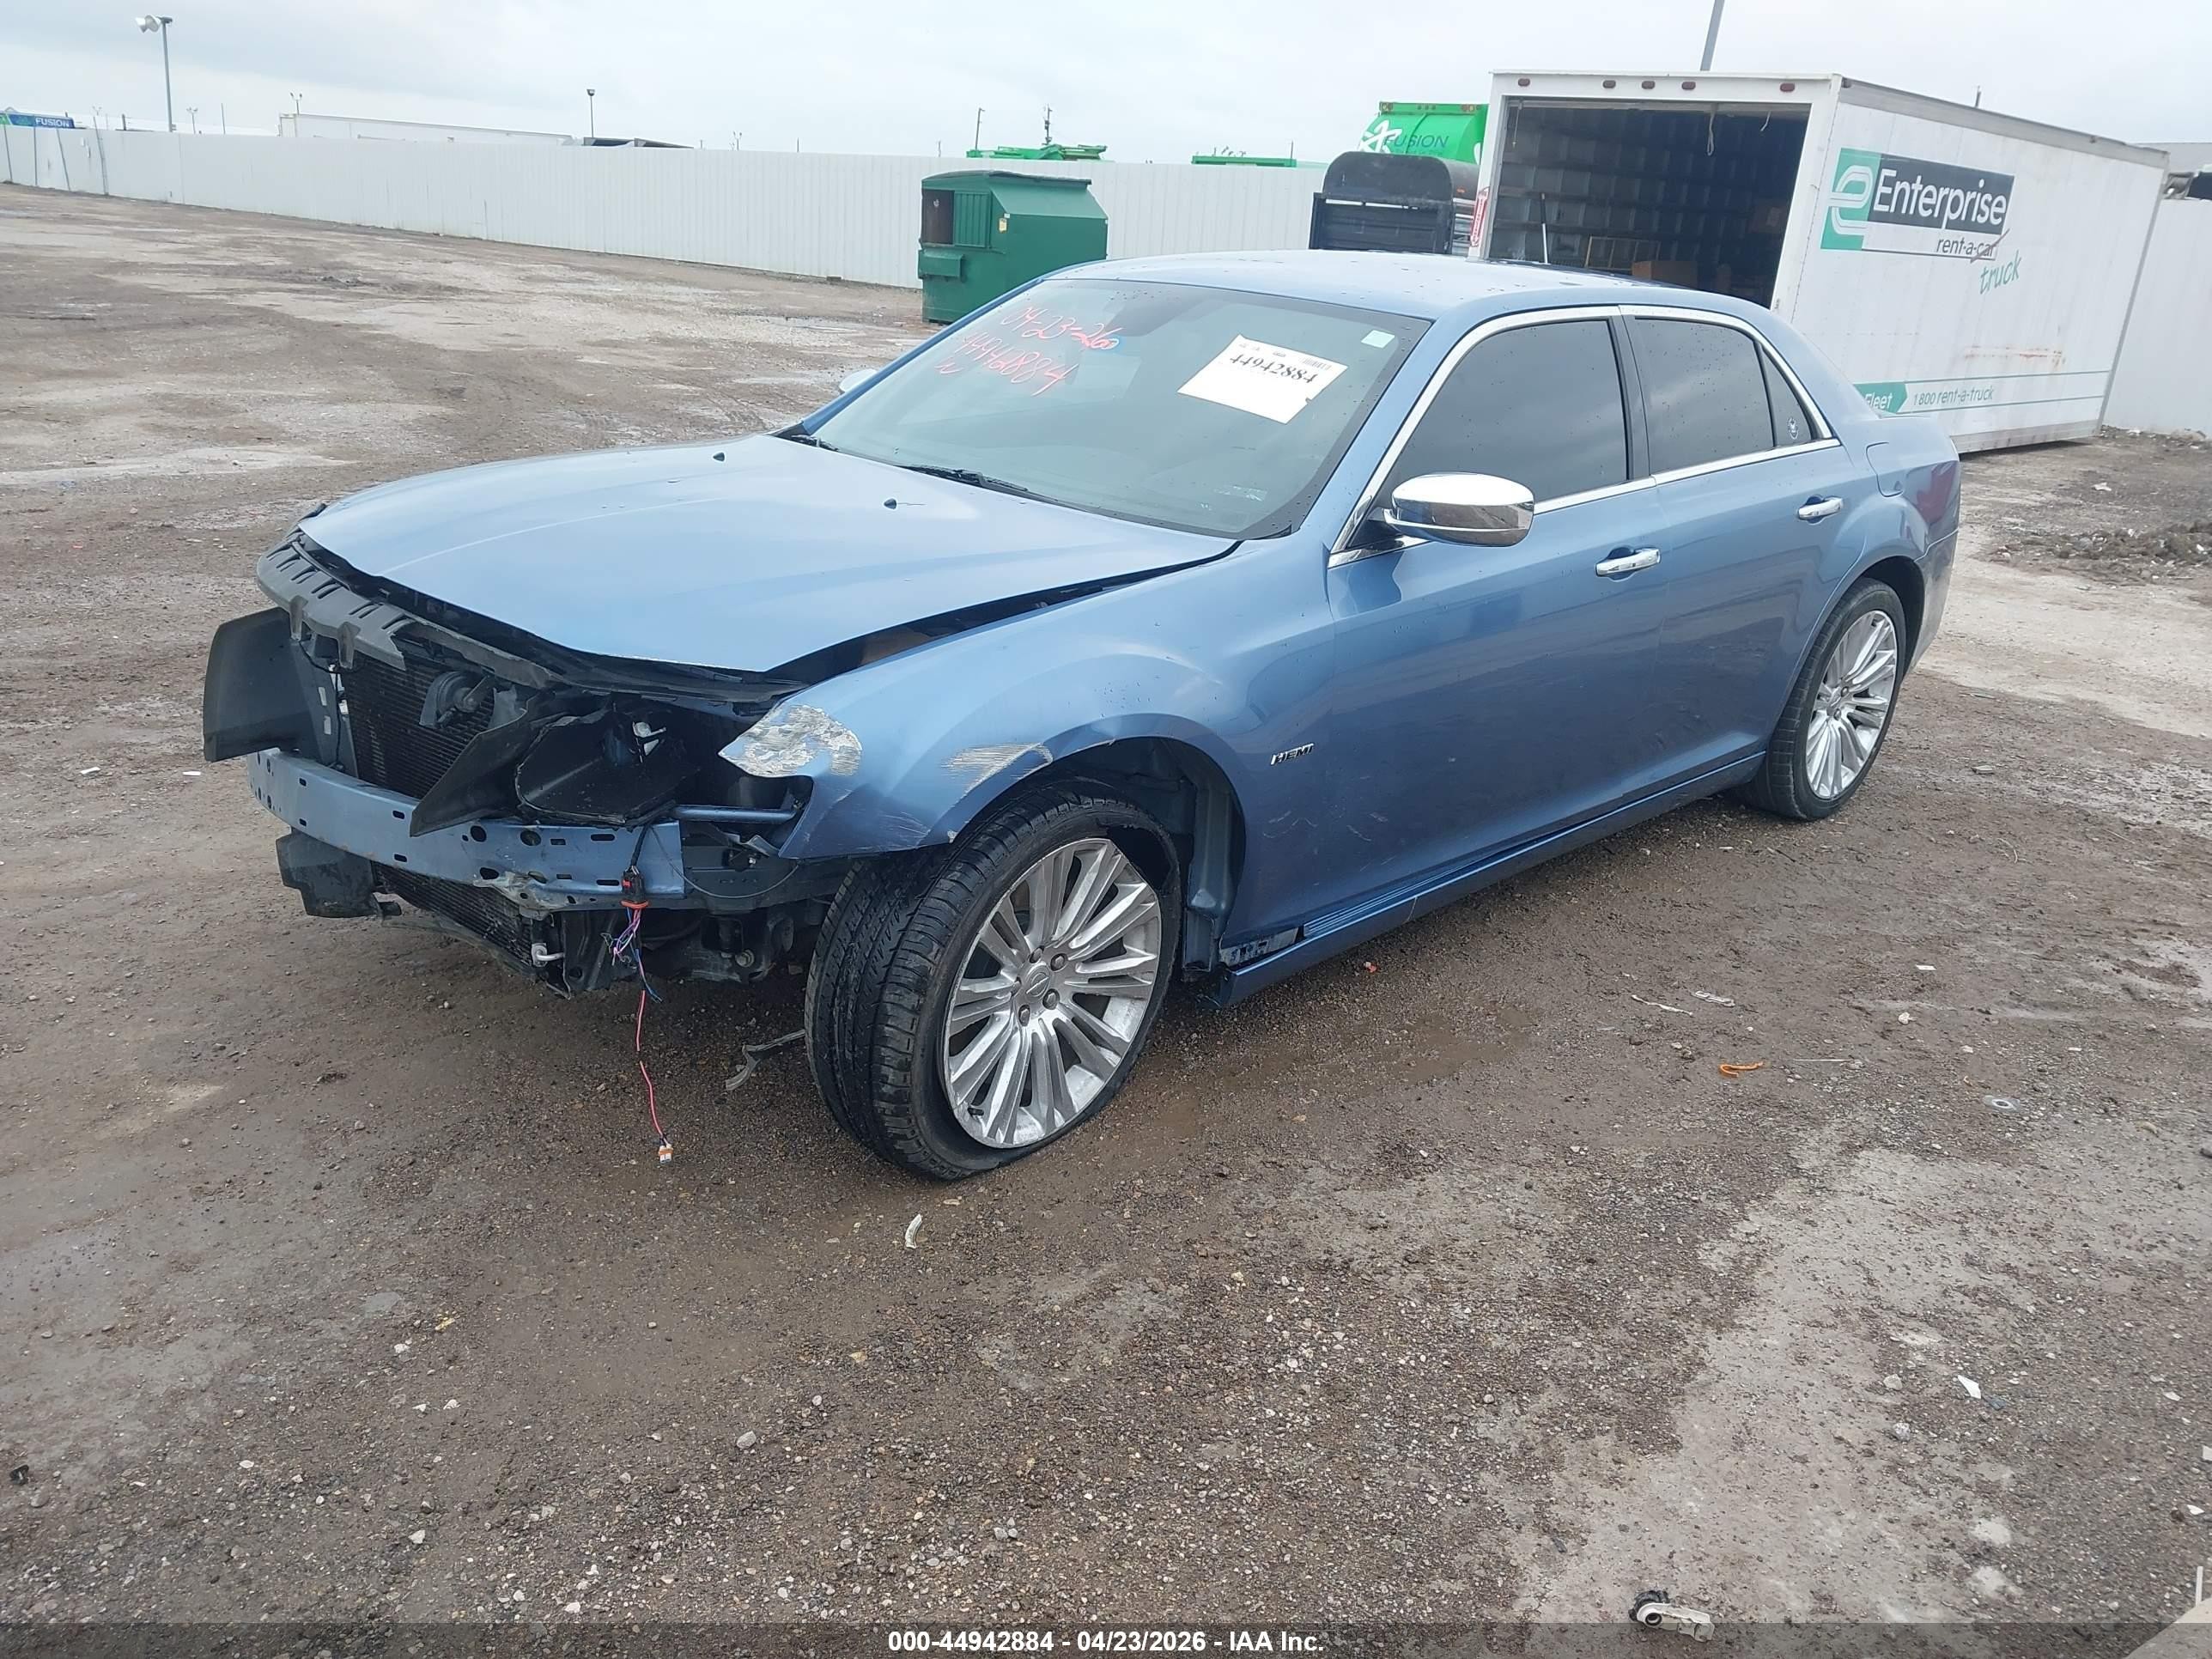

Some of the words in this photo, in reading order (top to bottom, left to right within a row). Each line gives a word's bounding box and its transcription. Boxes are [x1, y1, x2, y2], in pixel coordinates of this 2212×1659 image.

[35, 117, 70, 128] FUSION
[1383, 134, 1449, 149] FUSION
[1873, 168, 2008, 229] Enterprise
[1979, 249, 2022, 295] truck
[1230, 353, 1318, 384] 44942884
[1864, 392, 1893, 410] Fleet
[1918, 392, 1936, 406] 800
[1936, 386, 1995, 404] rent-a-truck
